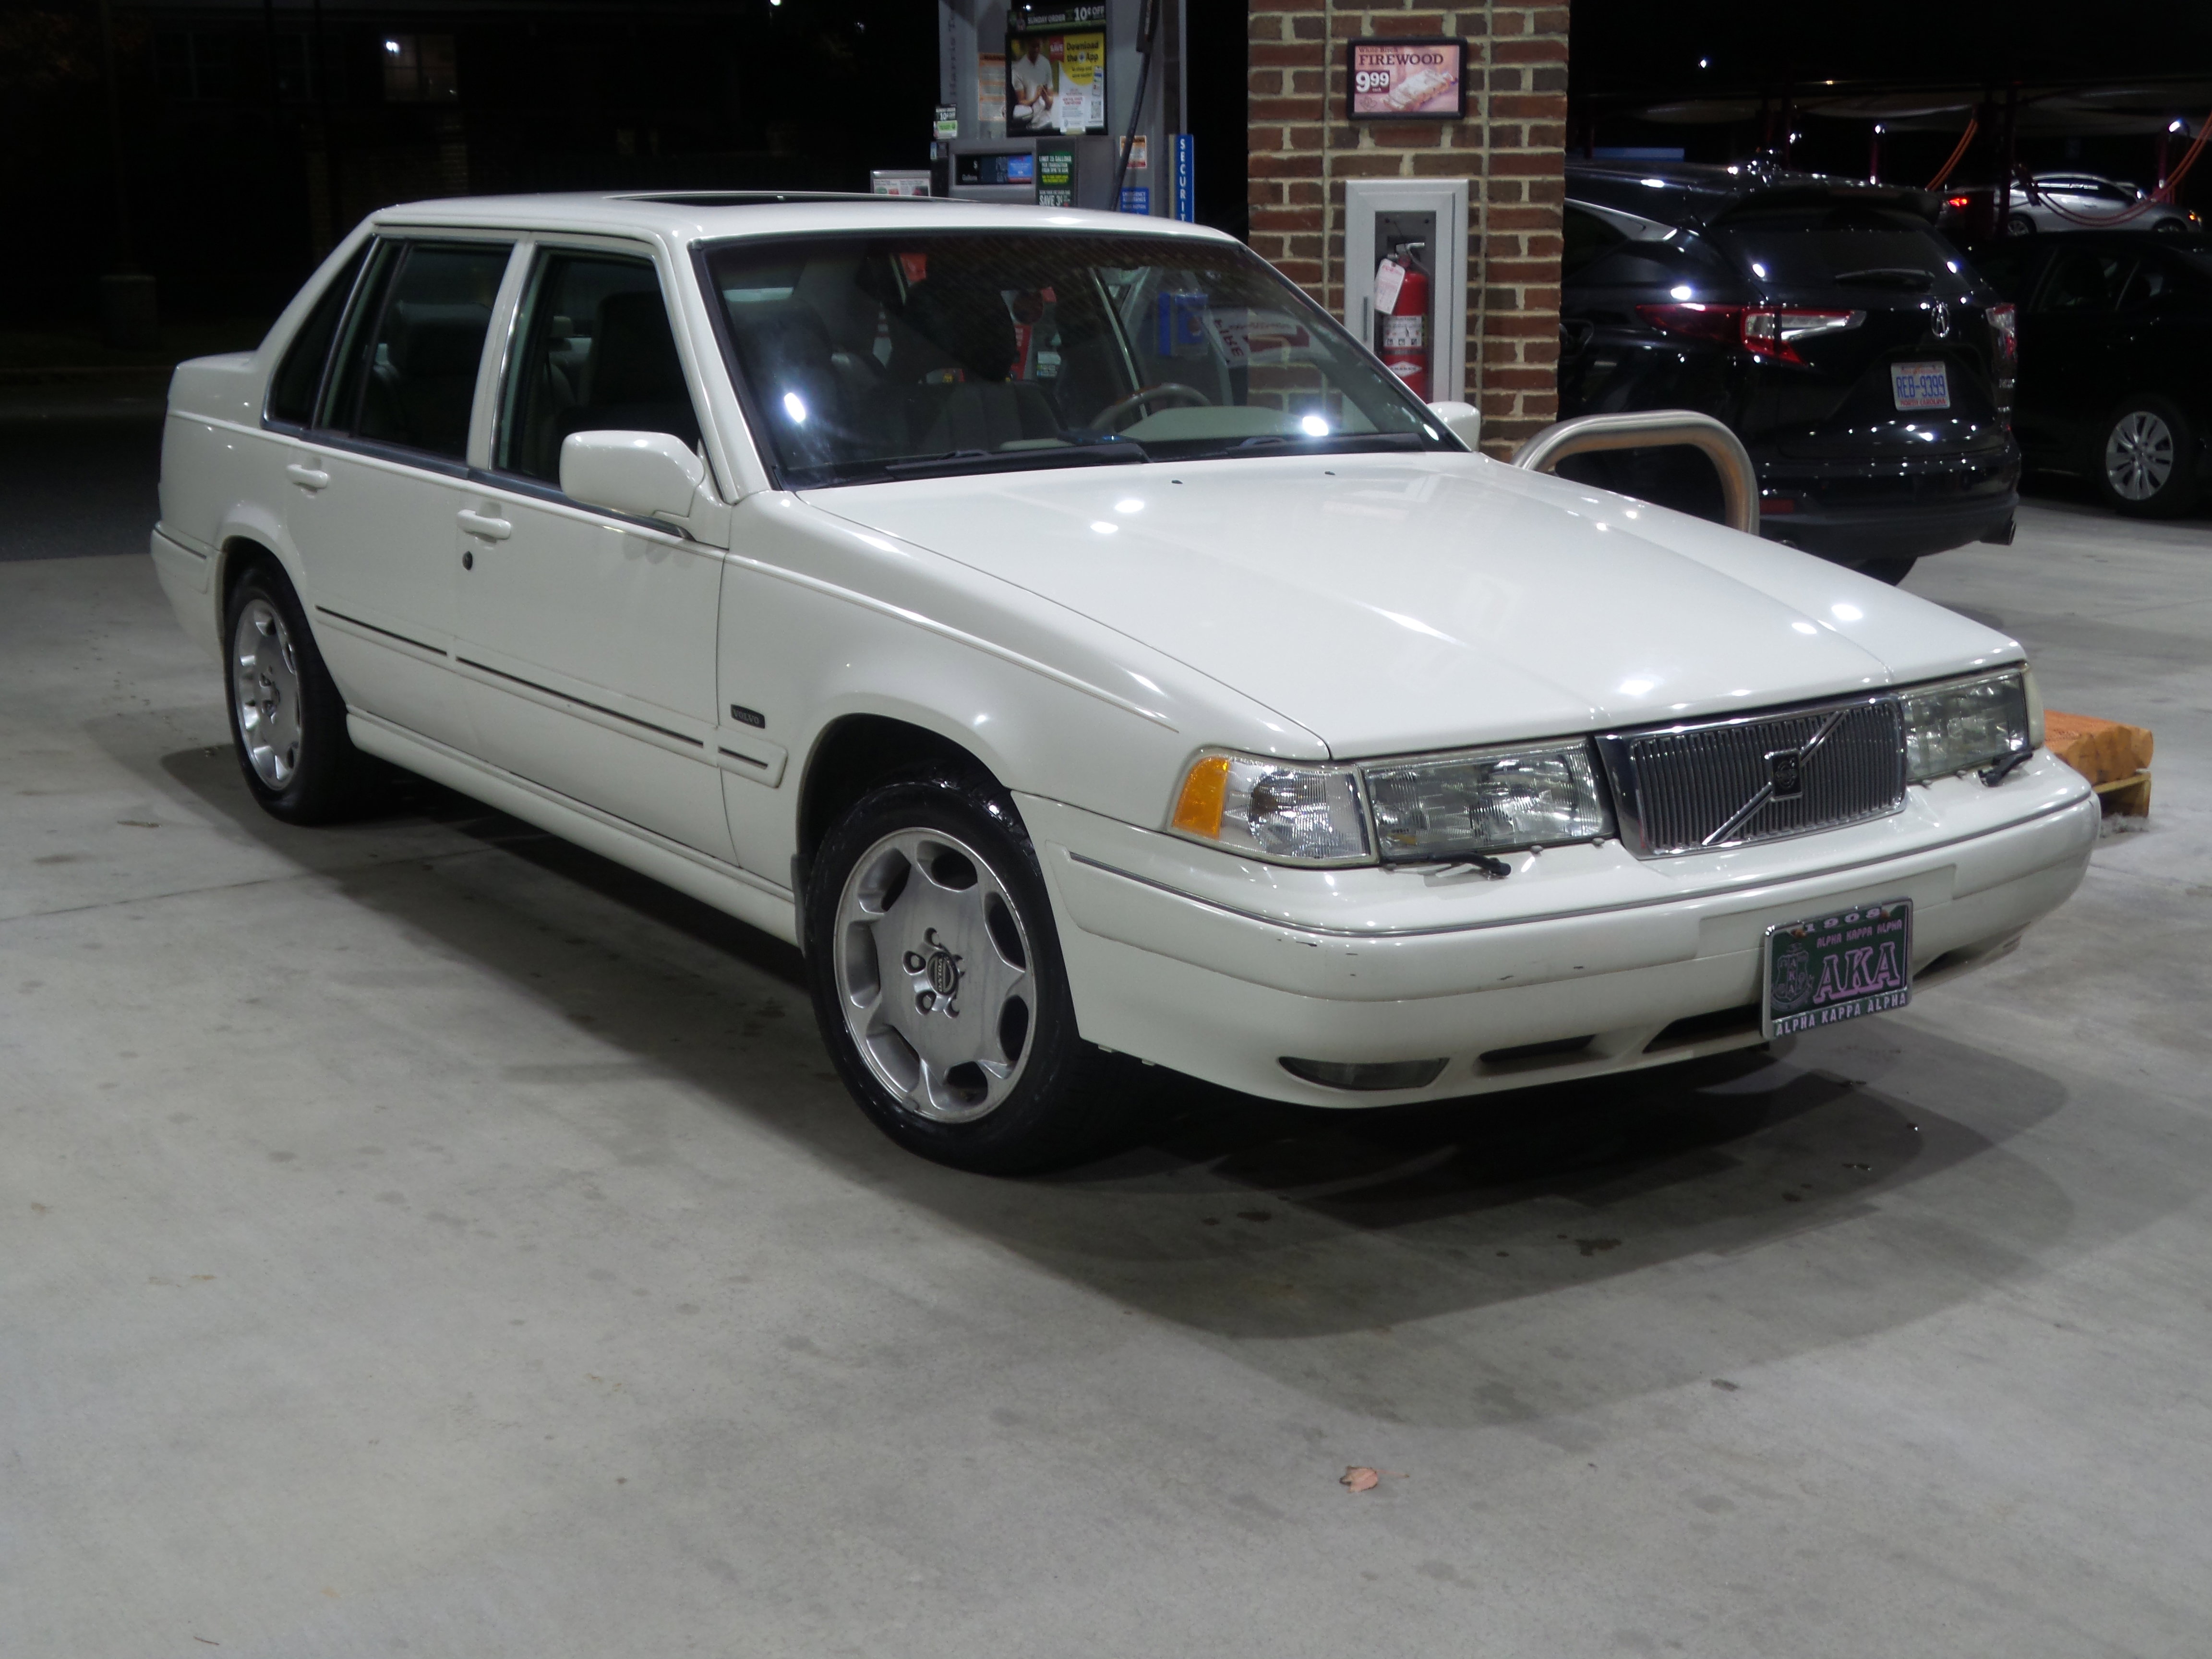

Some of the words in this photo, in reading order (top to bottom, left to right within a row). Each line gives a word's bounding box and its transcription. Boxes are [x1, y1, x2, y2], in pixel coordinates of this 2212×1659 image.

[1048, 14, 1066, 23] ORDER
[1067, 41, 1099, 50] Download
[1067, 53, 1077, 62] the
[1086, 53, 1098, 62] App
[1359, 53, 1444, 65] FIREWOOD
[1039, 195, 1055, 206] SAVE
[1897, 375, 1946, 397] REB-9399
[732, 709, 759, 723] VOLVO
[1817, 933, 1842, 948] ALPHA
[1846, 926, 1872, 941] KAPPA
[1877, 919, 1902, 934] ALPHA
[1813, 941, 1900, 1004] AKA
[1776, 1014, 1815, 1036] ALPHA
[1822, 1003, 1861, 1024] KAPPA
[1868, 992, 1906, 1013] ALPHA
